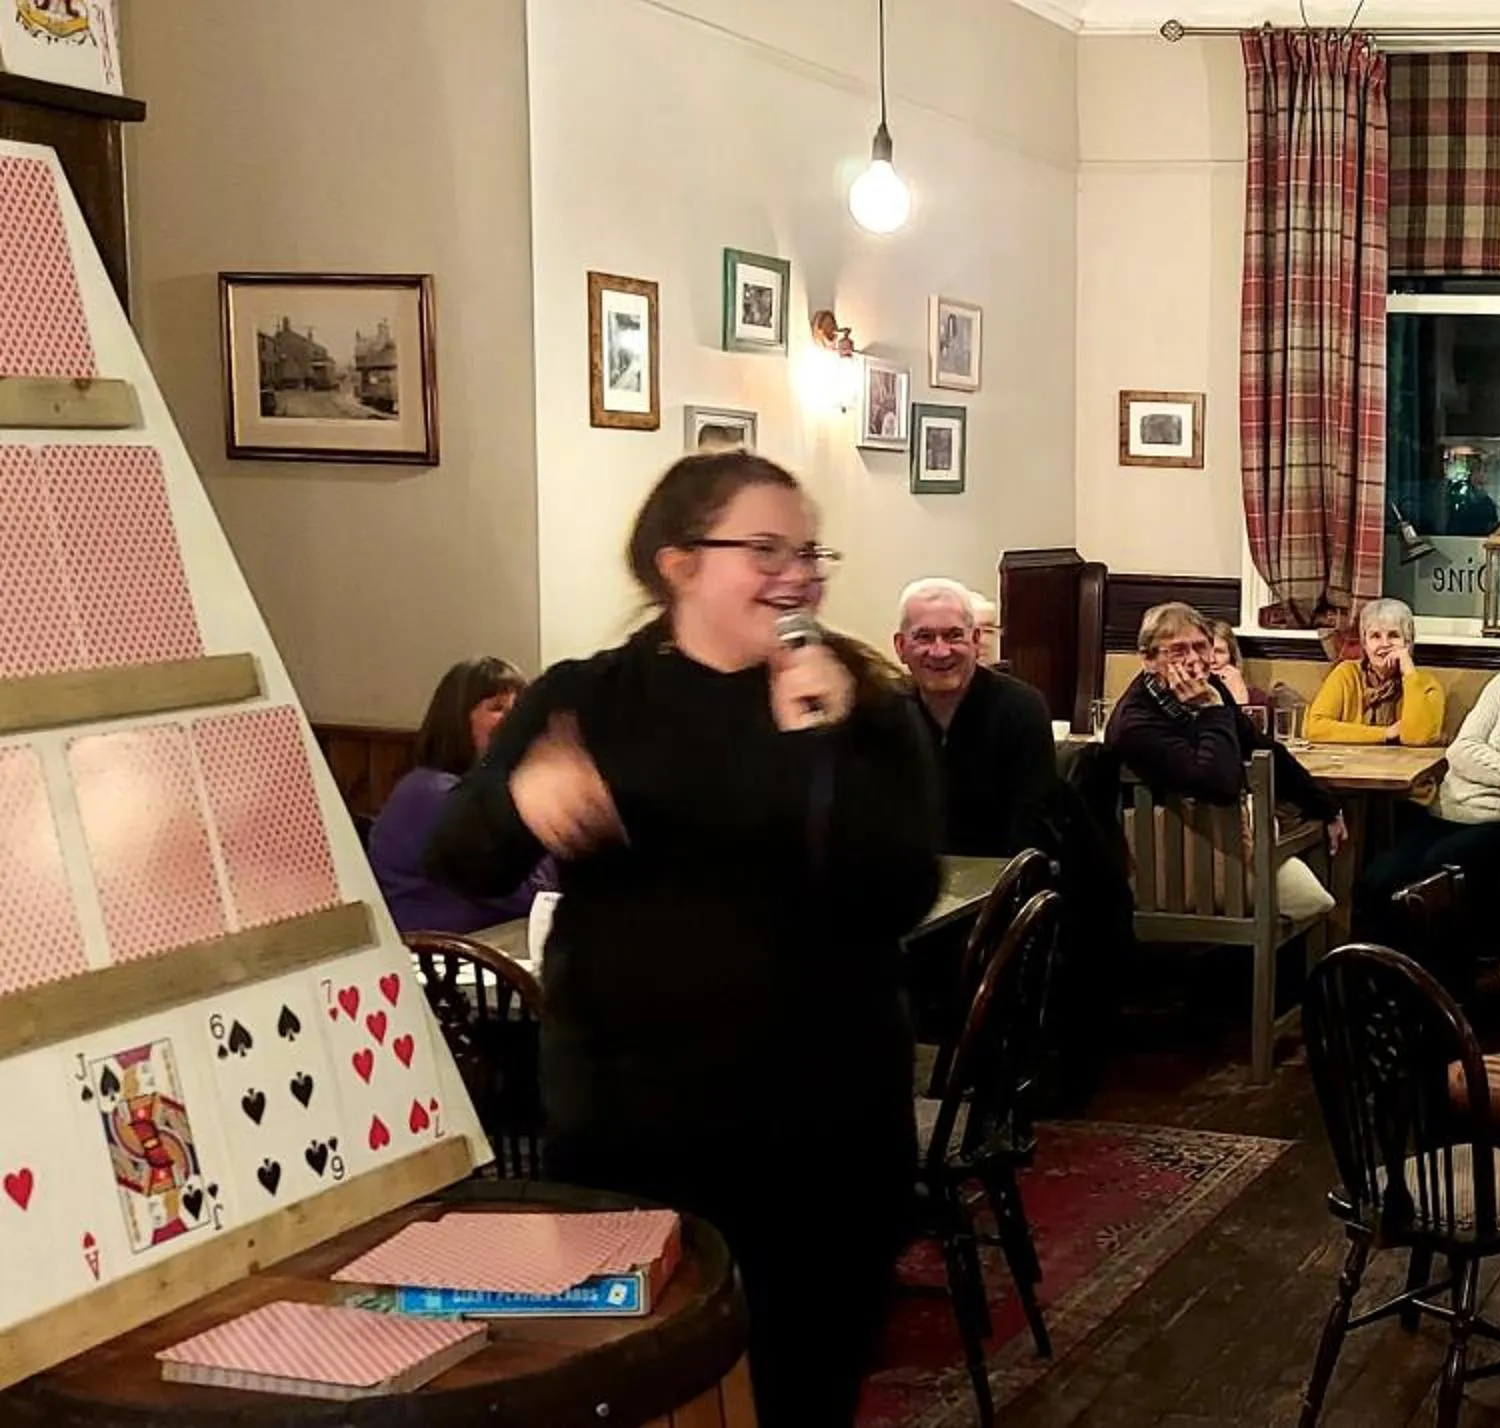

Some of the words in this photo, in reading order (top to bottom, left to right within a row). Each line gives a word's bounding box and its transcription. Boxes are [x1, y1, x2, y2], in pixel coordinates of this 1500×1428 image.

[319, 978, 332, 1004] 7
[209, 1013, 225, 1039] 6
[75, 1053, 87, 1080] J
[330, 1155, 345, 1181] 6
[212, 1203, 224, 1231] J
[84, 1249, 100, 1281] A
